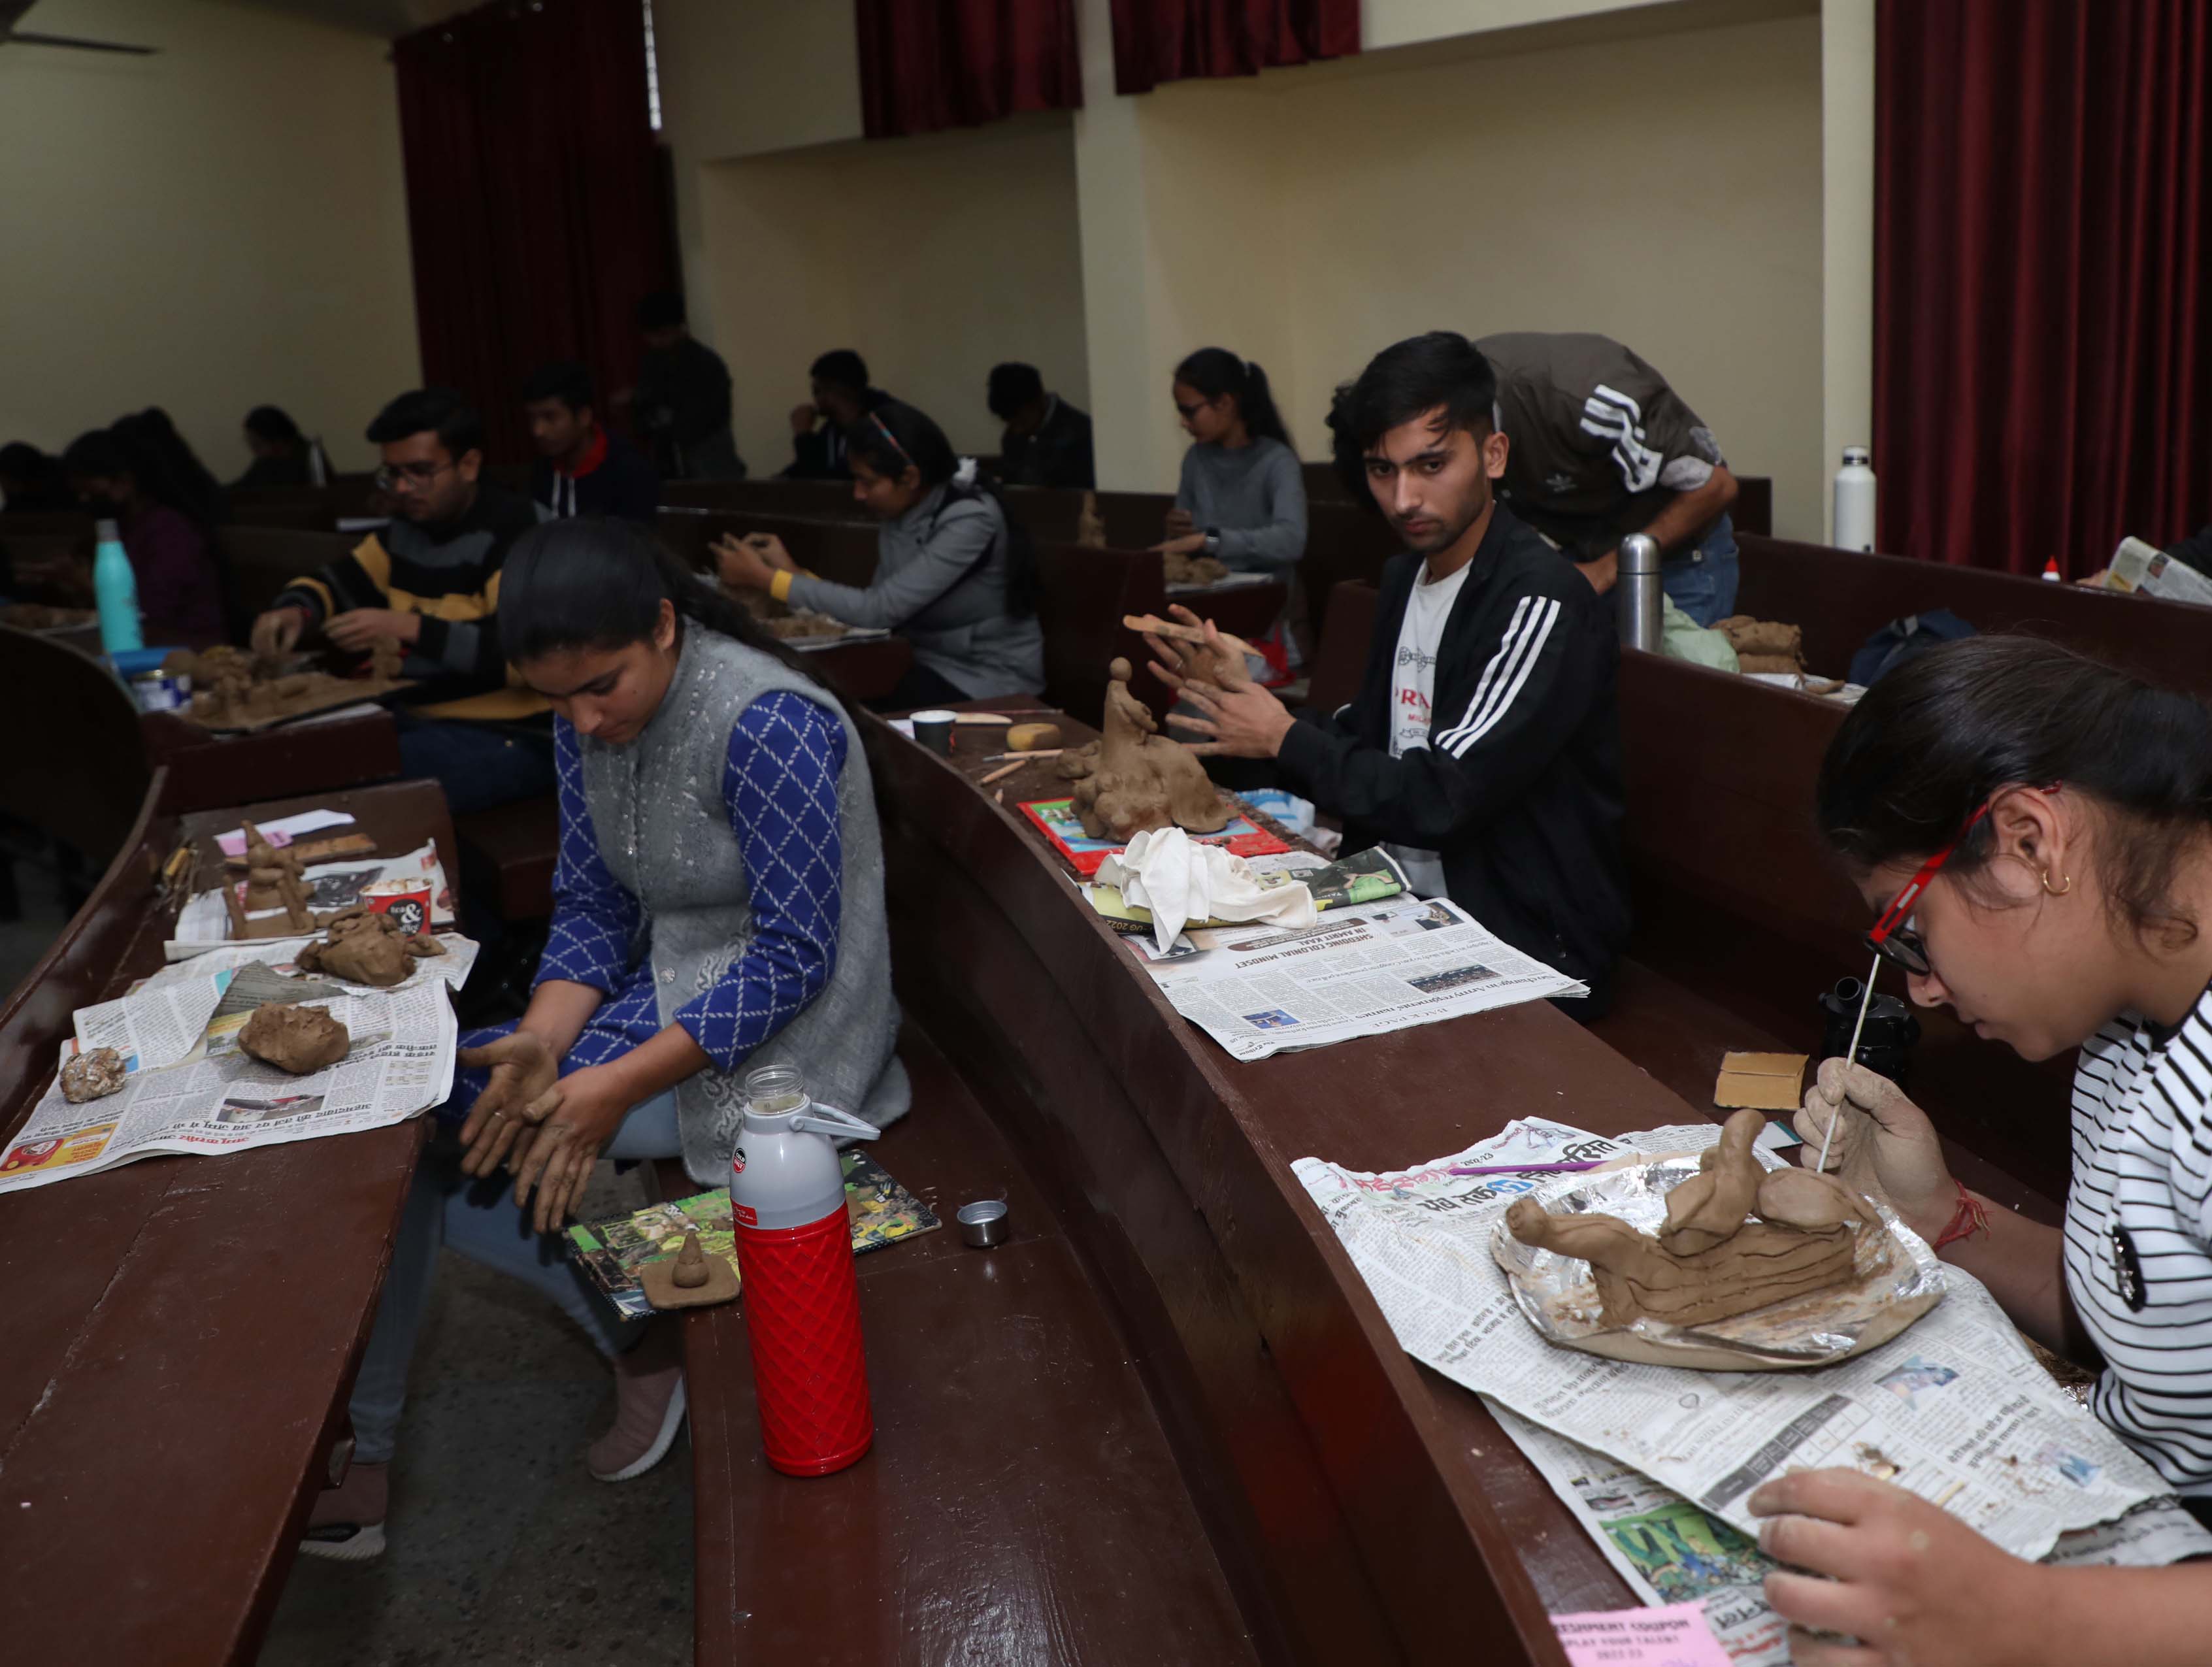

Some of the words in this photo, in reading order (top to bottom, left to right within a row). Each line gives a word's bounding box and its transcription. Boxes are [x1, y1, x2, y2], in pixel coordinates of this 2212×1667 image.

[401, 903, 421, 924] &
[1322, 929, 1354, 940] AMRIT
[1325, 933, 1374, 948] SHEDDING
[1295, 936, 1322, 946] KAAL
[1276, 943, 1326, 957] COLONIAL
[1233, 953, 1279, 969] MINDSET
[1495, 976, 1540, 987] change
[1450, 985, 1487, 998] Army
[1353, 1007, 1396, 1019] names
[1408, 1007, 1449, 1019] BACK
[1366, 1015, 1411, 1029] PAGE
[1239, 1044, 1263, 1056] Tribune
[314, 1102, 372, 1118] अहमदाबाद
[272, 1117, 293, 1126] तर्ज
[295, 1114, 312, 1122] की
[202, 1120, 229, 1129] जम्मू
[232, 1123, 252, 1132] अब
[734, 1159, 743, 1169] ONLY
[736, 1153, 745, 1163] COLD
[1415, 1196, 1462, 1212] अब
[1451, 1185, 1498, 1206] तक
[1630, 1619, 1690, 1632] COUPON
